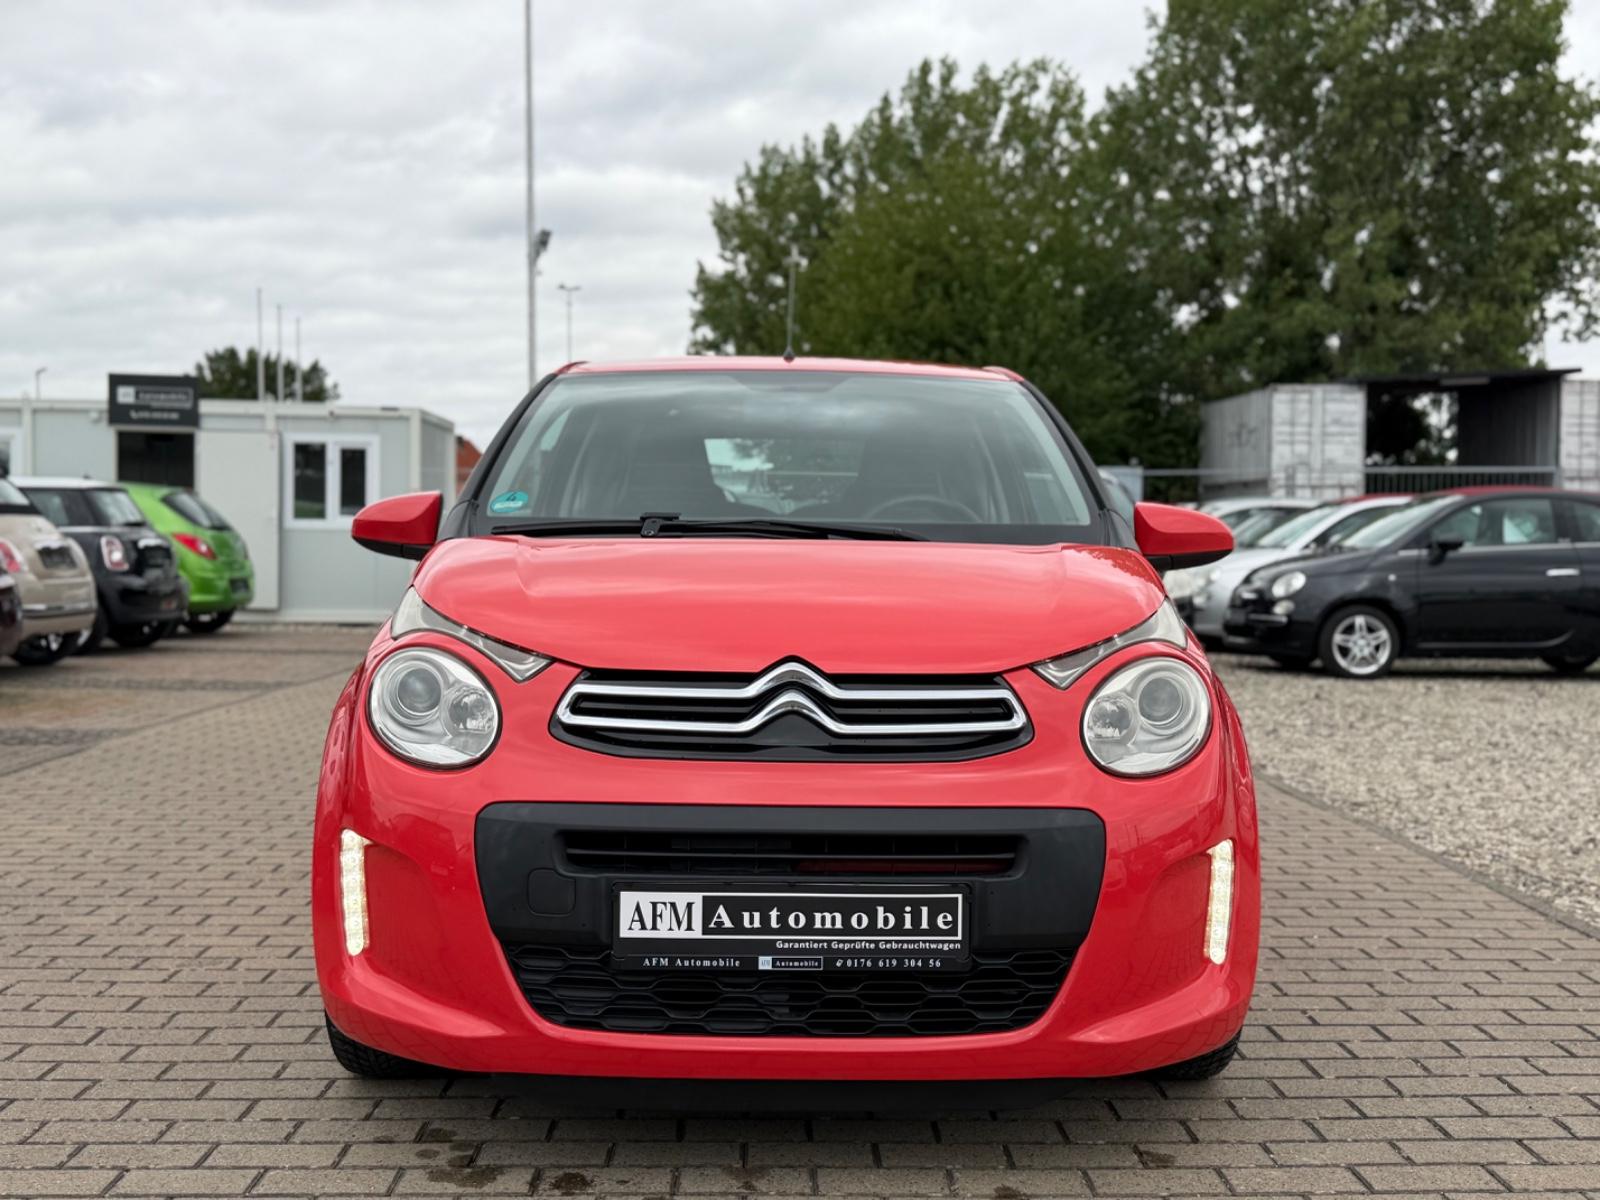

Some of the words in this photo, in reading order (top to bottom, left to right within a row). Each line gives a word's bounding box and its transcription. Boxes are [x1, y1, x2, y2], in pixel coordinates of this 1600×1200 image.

[627, 900, 696, 932] AFM
[708, 904, 953, 930] Automobile
[775, 940, 828, 949] Garantiert
[831, 941, 876, 951] Geprüfte
[878, 941, 961, 951] Gebrauchtwagen
[642, 957, 669, 967] AFM
[675, 957, 741, 967] Automobile
[846, 958, 872, 968] 0176
[878, 958, 897, 968] 619
[903, 959, 922, 968] 304
[928, 959, 942, 968] 56
